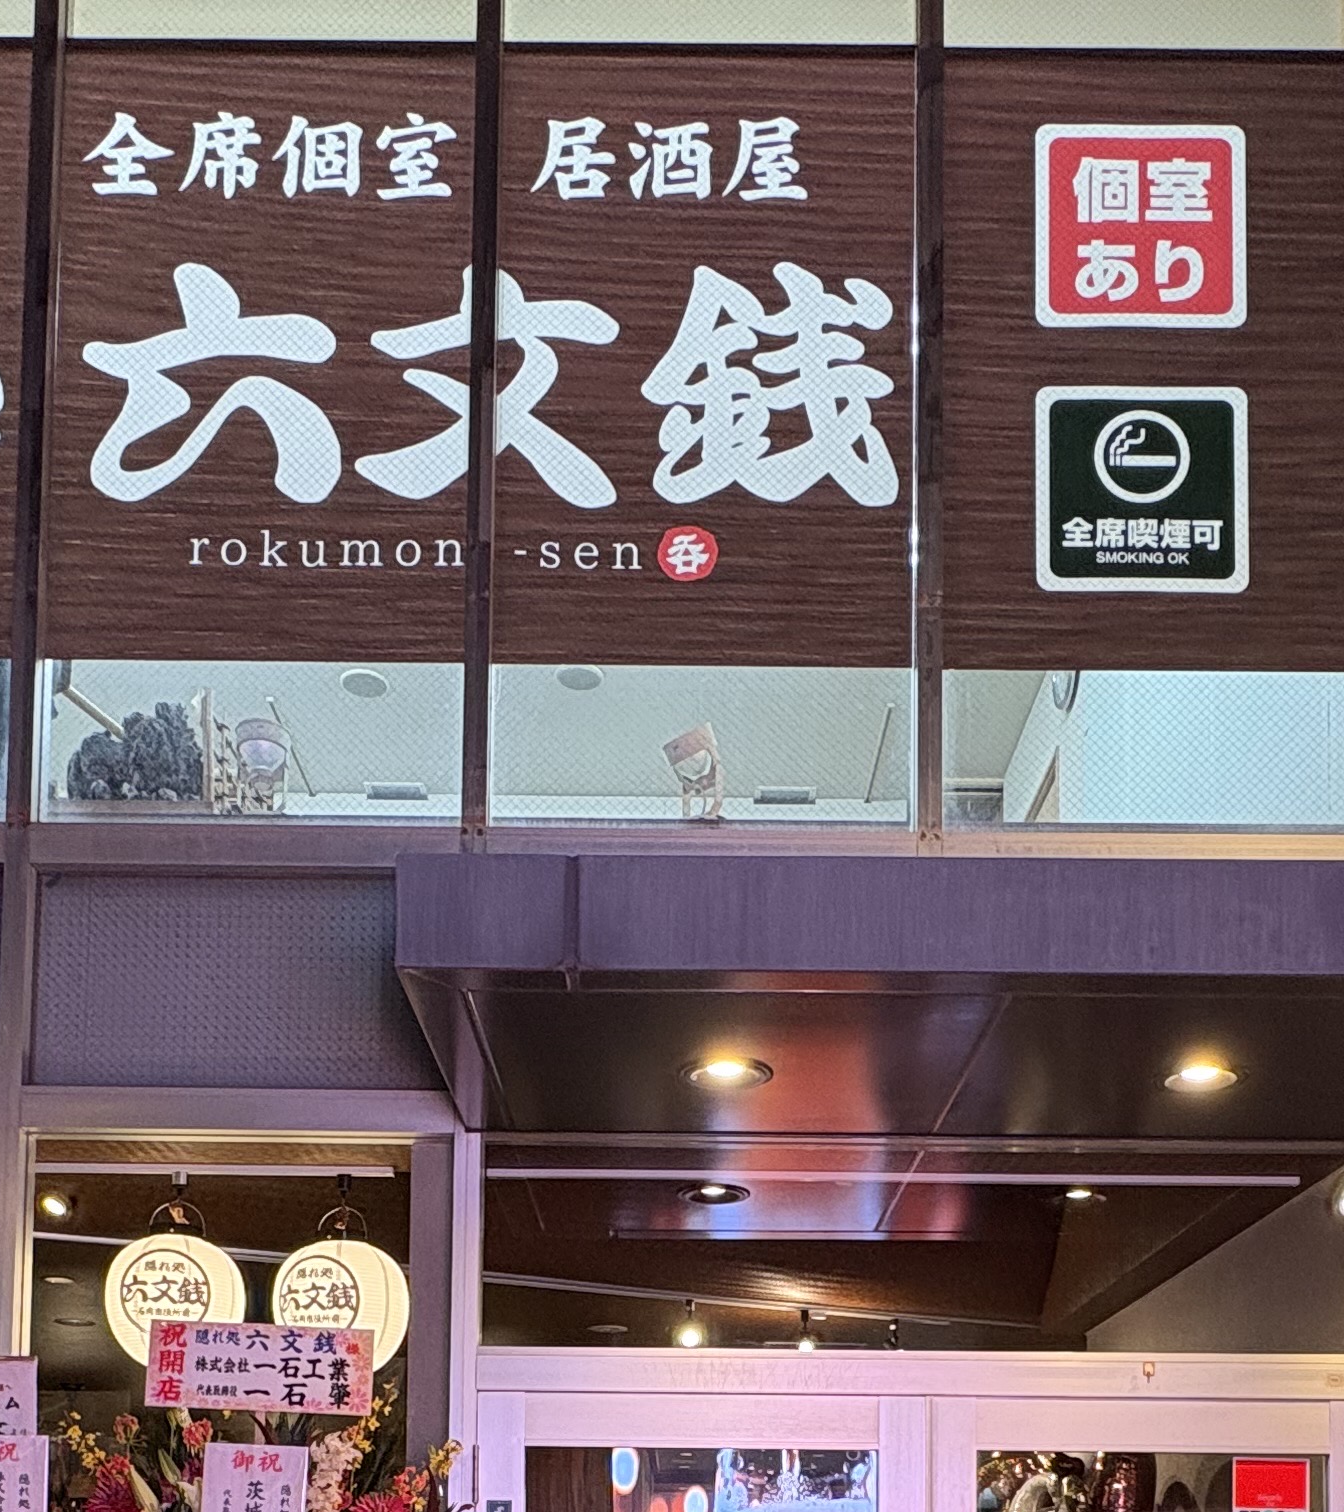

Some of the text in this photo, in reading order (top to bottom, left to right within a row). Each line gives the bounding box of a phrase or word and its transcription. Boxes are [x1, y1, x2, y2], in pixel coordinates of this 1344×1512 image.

[83, 112, 808, 201] 全席個室 居酒屋
[1073, 157, 1214, 225] 個室
[1075, 239, 1204, 302] あり
[83, 261, 899, 507] 六文銭
[1062, 516, 1223, 551] 全席喫煙可
[1096, 551, 1190, 565] SMOKING OK
[123, 1275, 207, 1306] 六文銭
[281, 1282, 356, 1312] 六文銭
[195, 1329, 241, 1346] 隠れ処
[245, 1329, 338, 1355] 六文銭
[155, 1322, 187, 1401] 祝開店
[231, 1449, 283, 1473] 御祝
